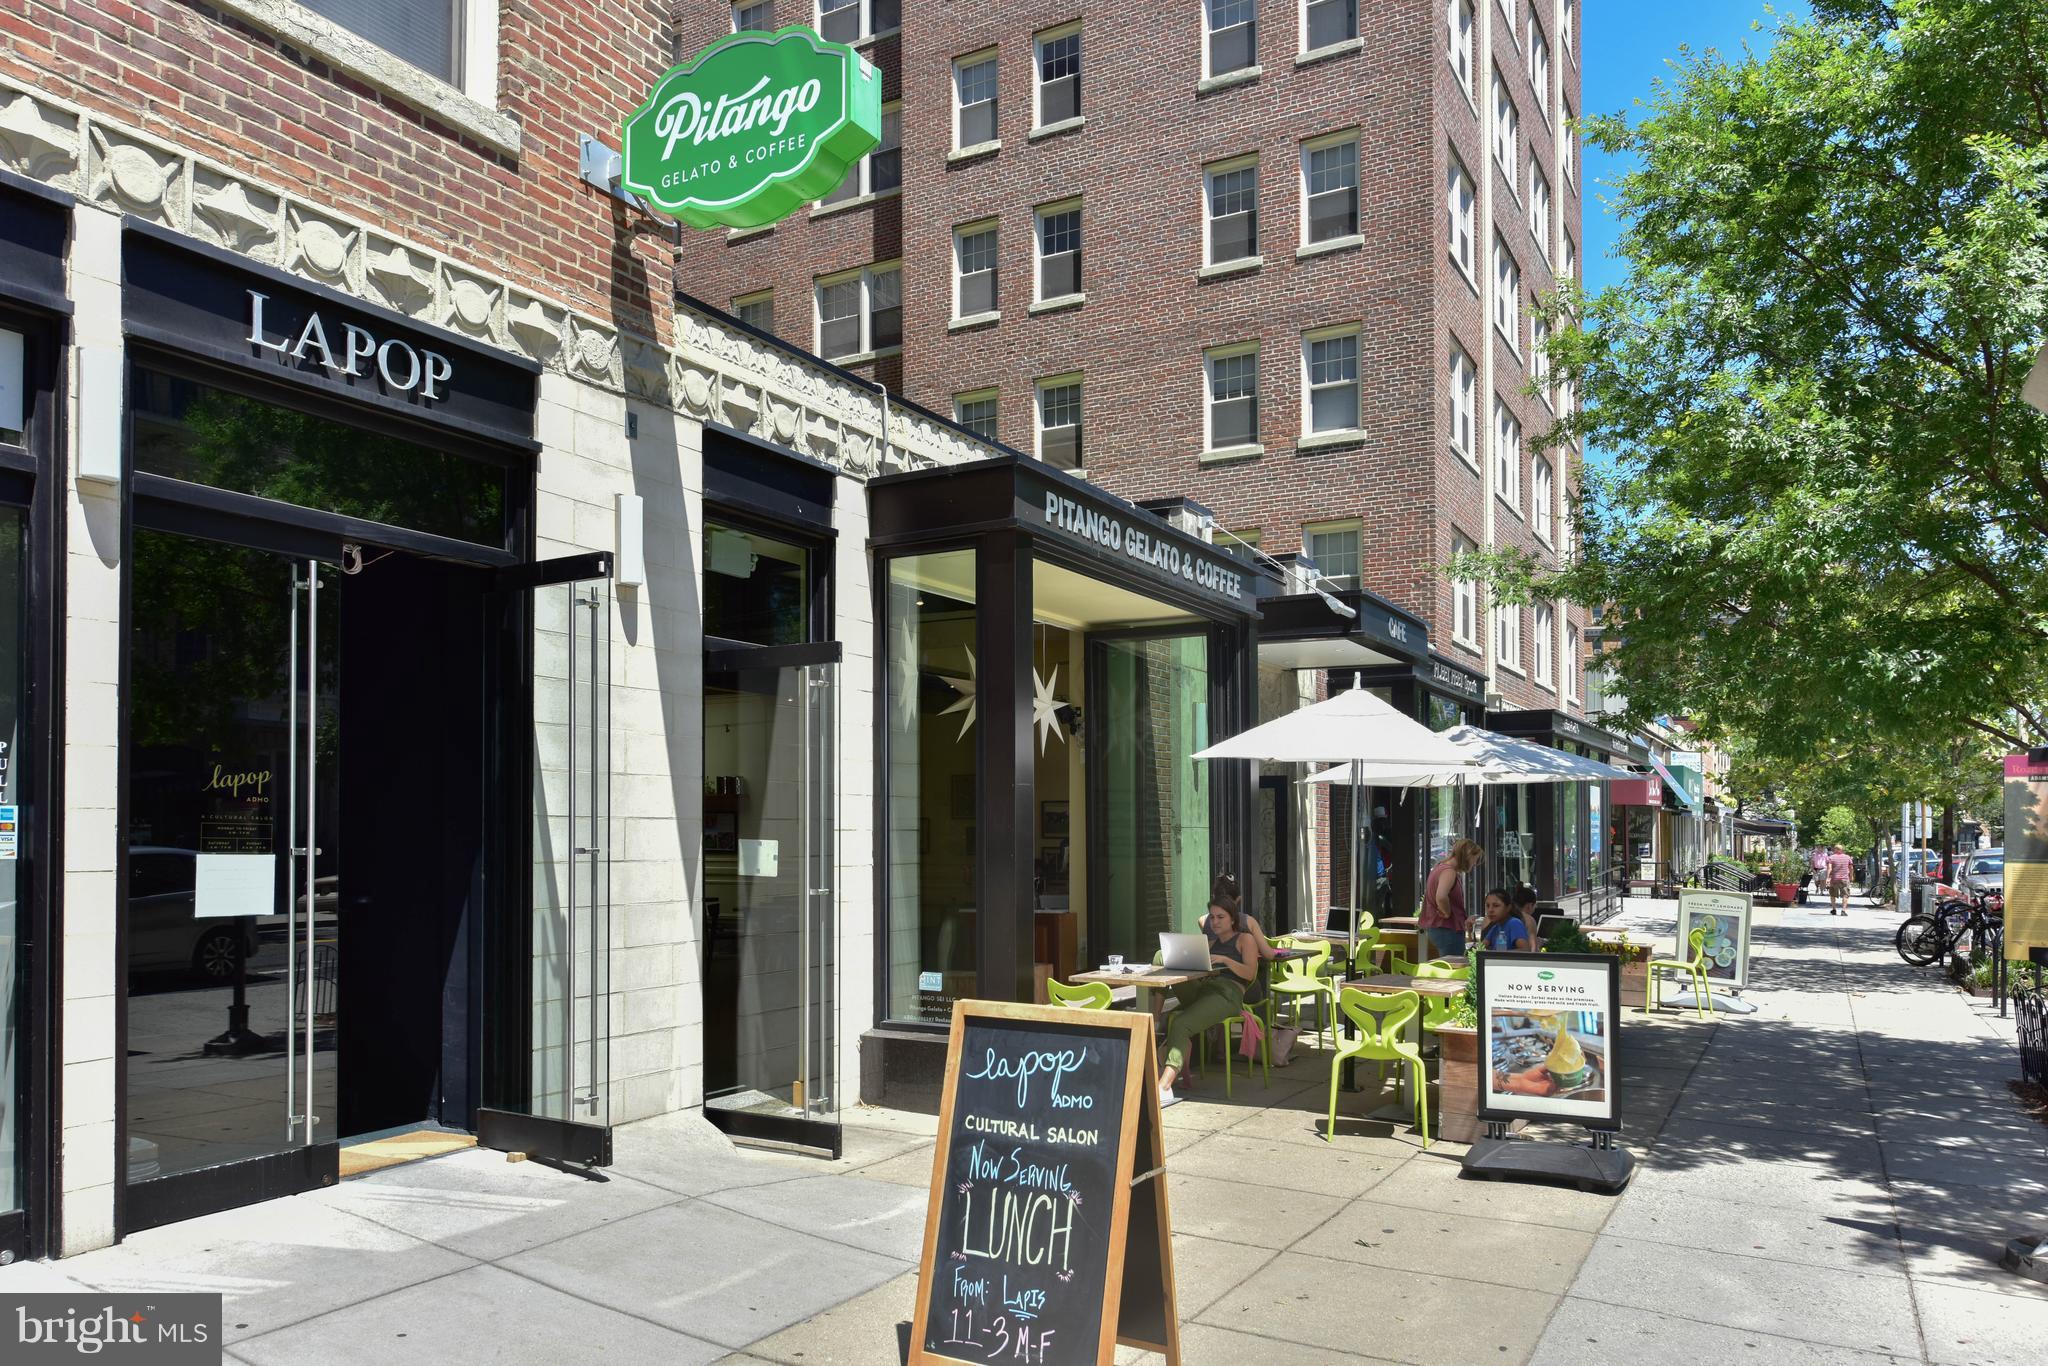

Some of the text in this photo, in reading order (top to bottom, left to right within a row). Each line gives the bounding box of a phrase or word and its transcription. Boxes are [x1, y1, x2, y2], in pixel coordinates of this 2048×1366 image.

[655, 75, 821, 161] Pitango
[661, 134, 806, 188] GELATO & COFFEE
[245, 289, 452, 400] LAPOP
[1045, 491, 1241, 600] PITANGO GELATO & COFFEE
[202, 764, 273, 798] lapop
[1537, 984, 1585, 994] SERVING
[965, 1046, 1087, 1108] lapop
[1052, 1094, 1093, 1109] ADMO
[965, 1114, 1098, 1145] CULTURAL SALON
[962, 1187, 1074, 1271] LUNCH
[1014, 1325, 1056, 1364] M-F
